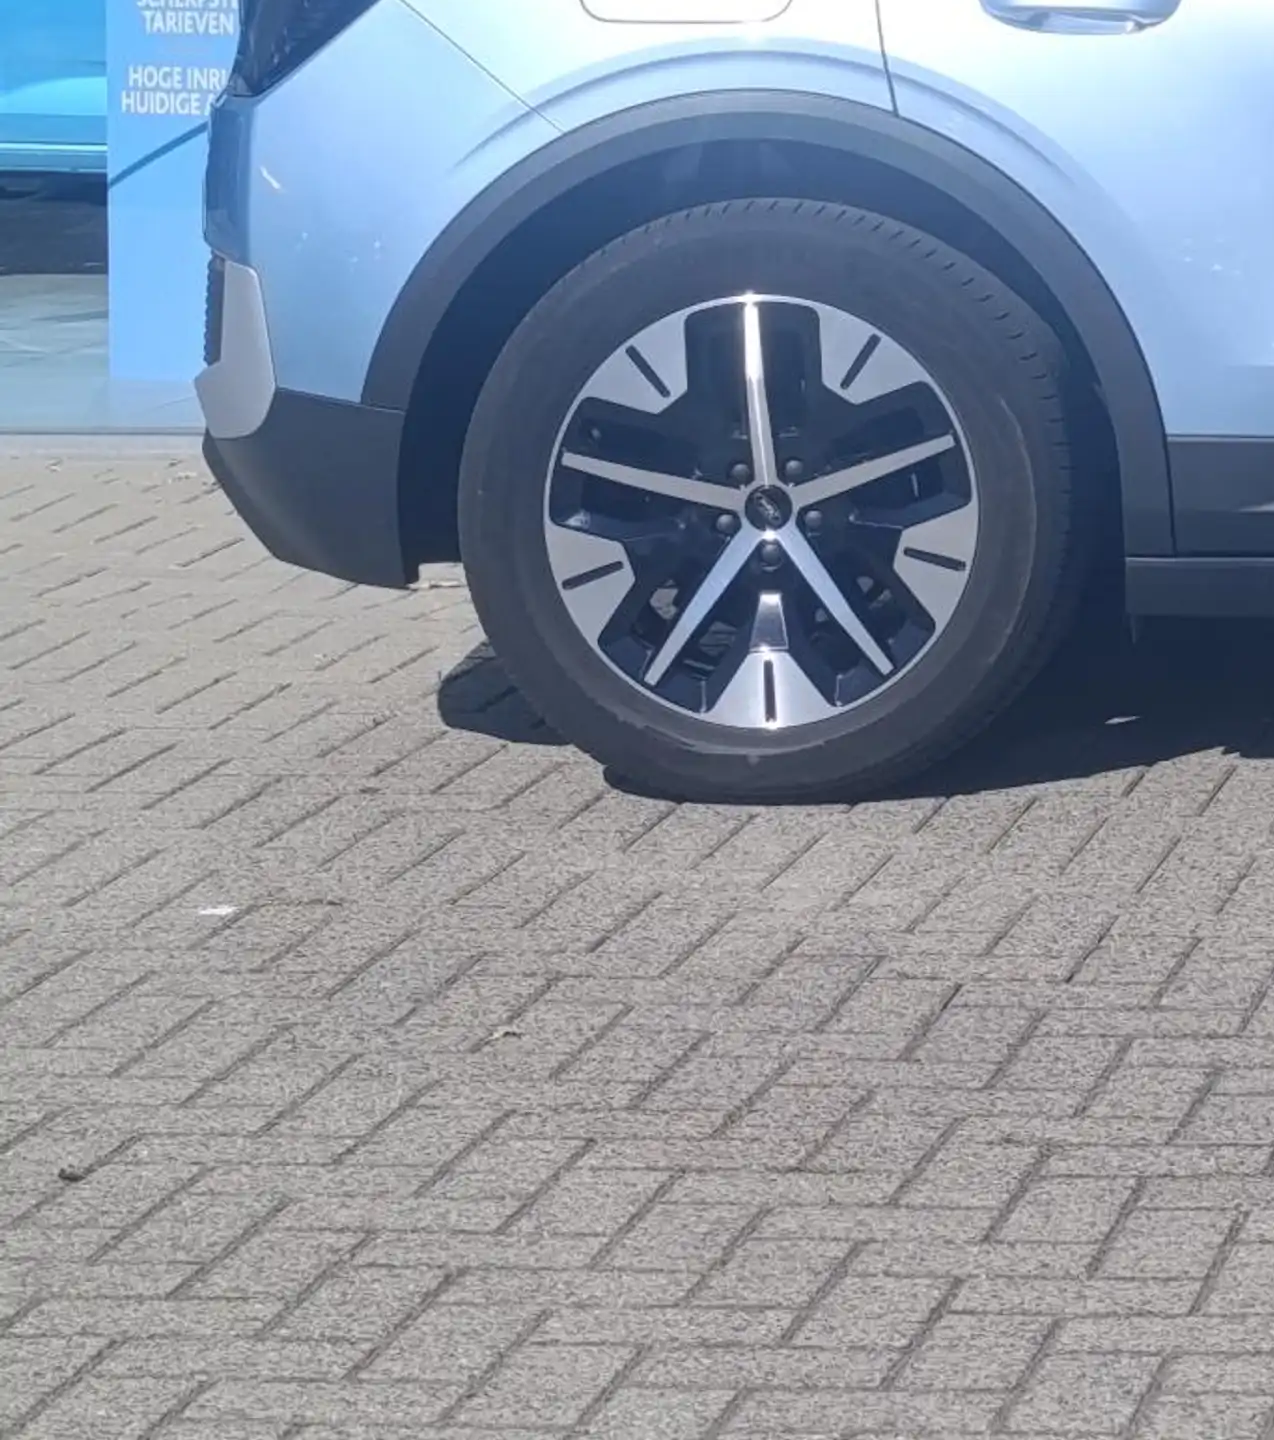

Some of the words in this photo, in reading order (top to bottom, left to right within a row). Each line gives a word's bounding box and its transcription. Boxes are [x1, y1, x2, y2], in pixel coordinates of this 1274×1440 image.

[142, 10, 234, 35] TARIEVEN
[128, 66, 183, 89] HOGE
[121, 90, 201, 115] HUIDIGE
